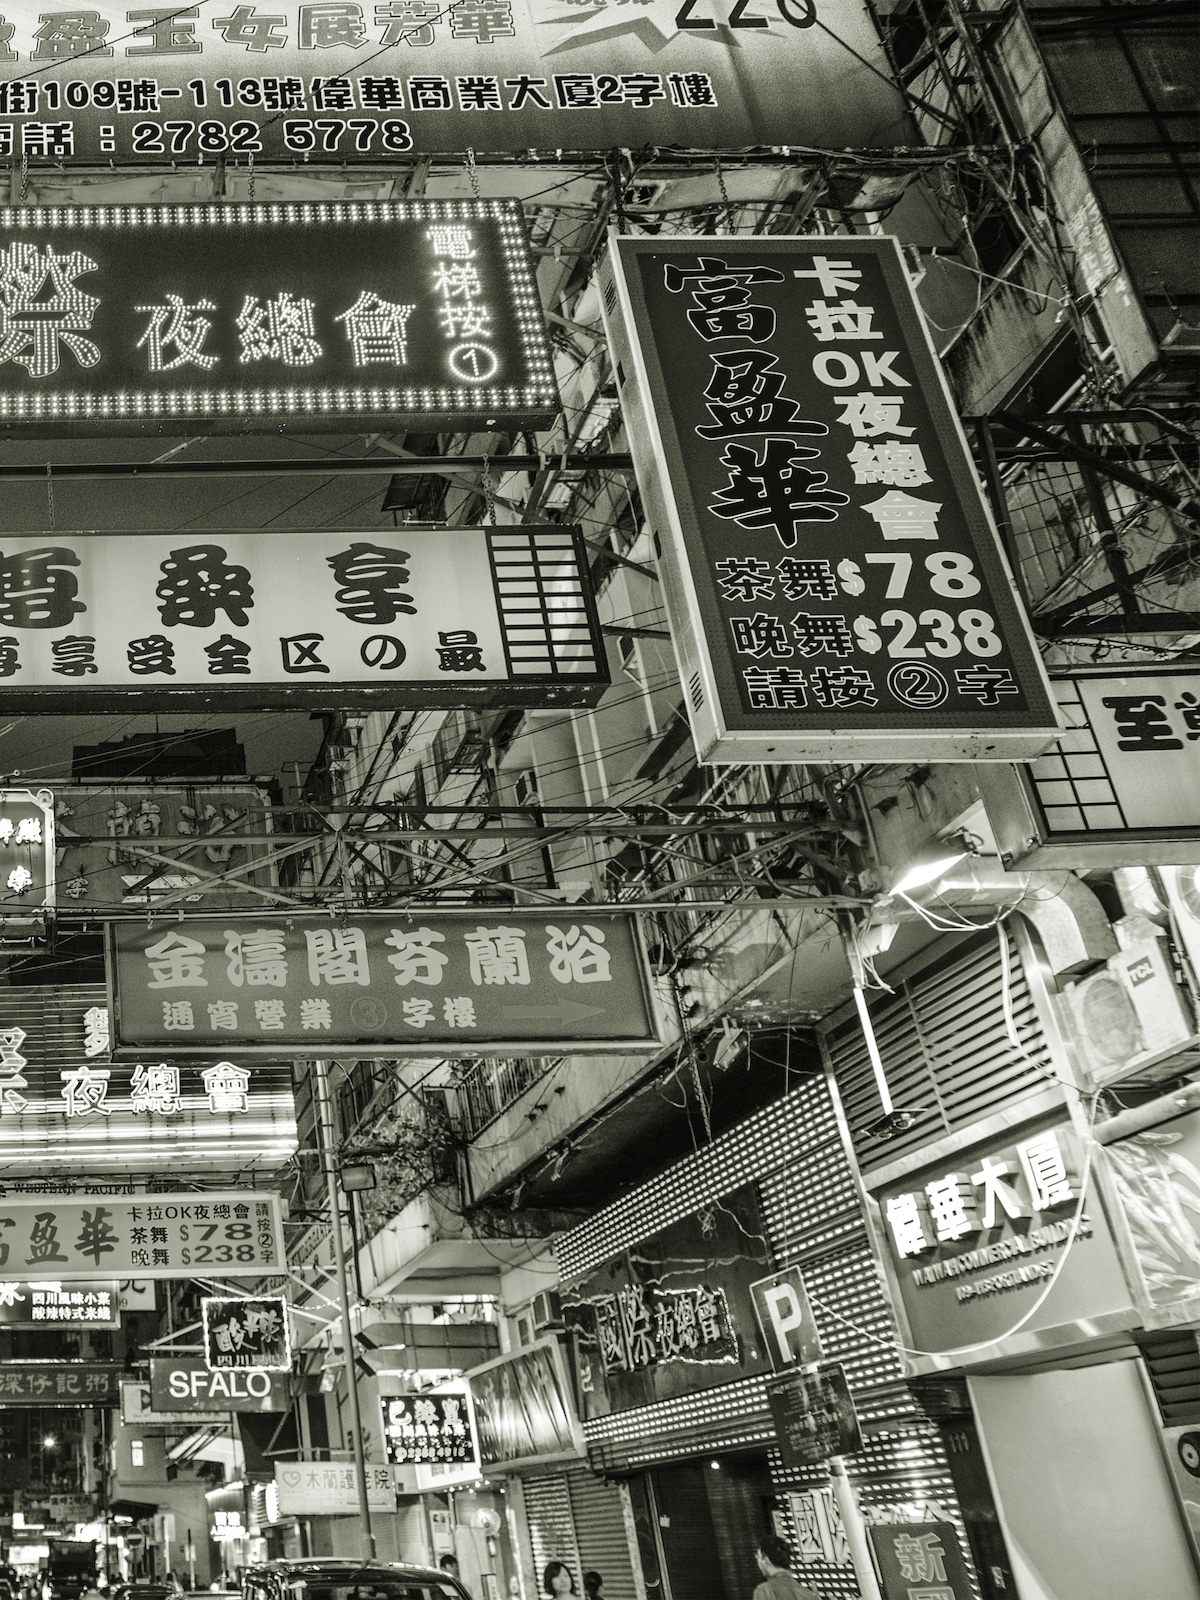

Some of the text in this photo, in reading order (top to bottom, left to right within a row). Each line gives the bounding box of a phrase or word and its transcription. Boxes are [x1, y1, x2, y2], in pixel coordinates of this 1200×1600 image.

[130, 120, 262, 155] 2782
[283, 118, 413, 153] 5778
[663, 256, 851, 549] 富盈華
[793, 255, 944, 541] 卡拉OK夜總會
[143, 924, 613, 989] 金濤閣芬蘭浴
[1128, 960, 1154, 983] TCL
[14, 1182, 77, 1196] WESTERN
[127, 1202, 251, 1221] 卡拉OK夜總會
[764, 1282, 802, 1364] P
[169, 1370, 272, 1400] SFALO
